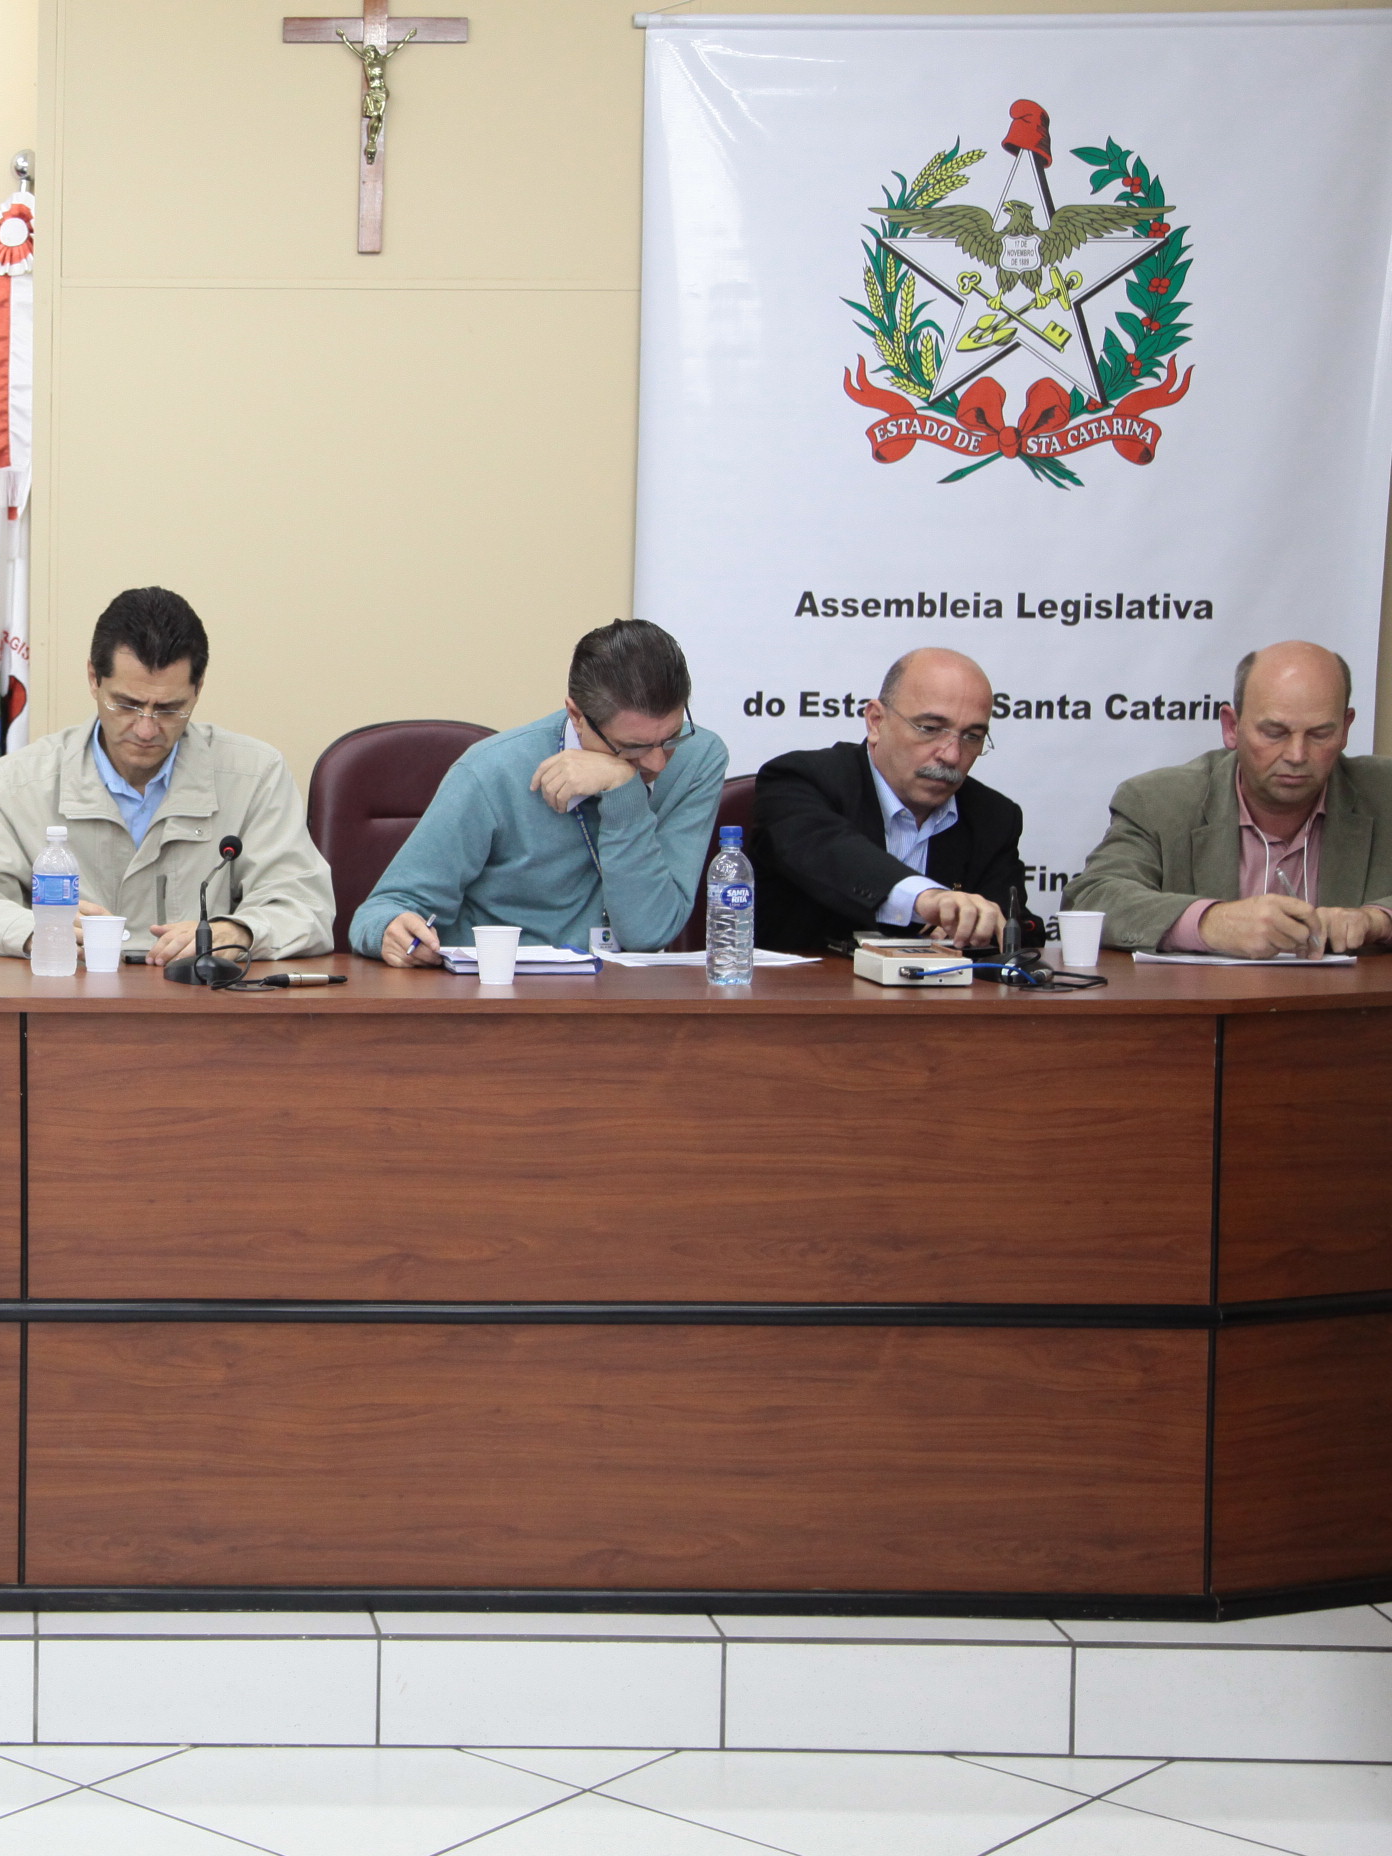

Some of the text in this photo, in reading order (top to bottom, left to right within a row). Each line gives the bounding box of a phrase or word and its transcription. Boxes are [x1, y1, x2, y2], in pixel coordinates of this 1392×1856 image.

[873, 418, 952, 443] ESTADO
[953, 431, 982, 453] DE
[794, 591, 1214, 627] Assembleia Legislativa
[743, 691, 1231, 720] do Esta Santa Catarin
[726, 889, 750, 897] SANTA
